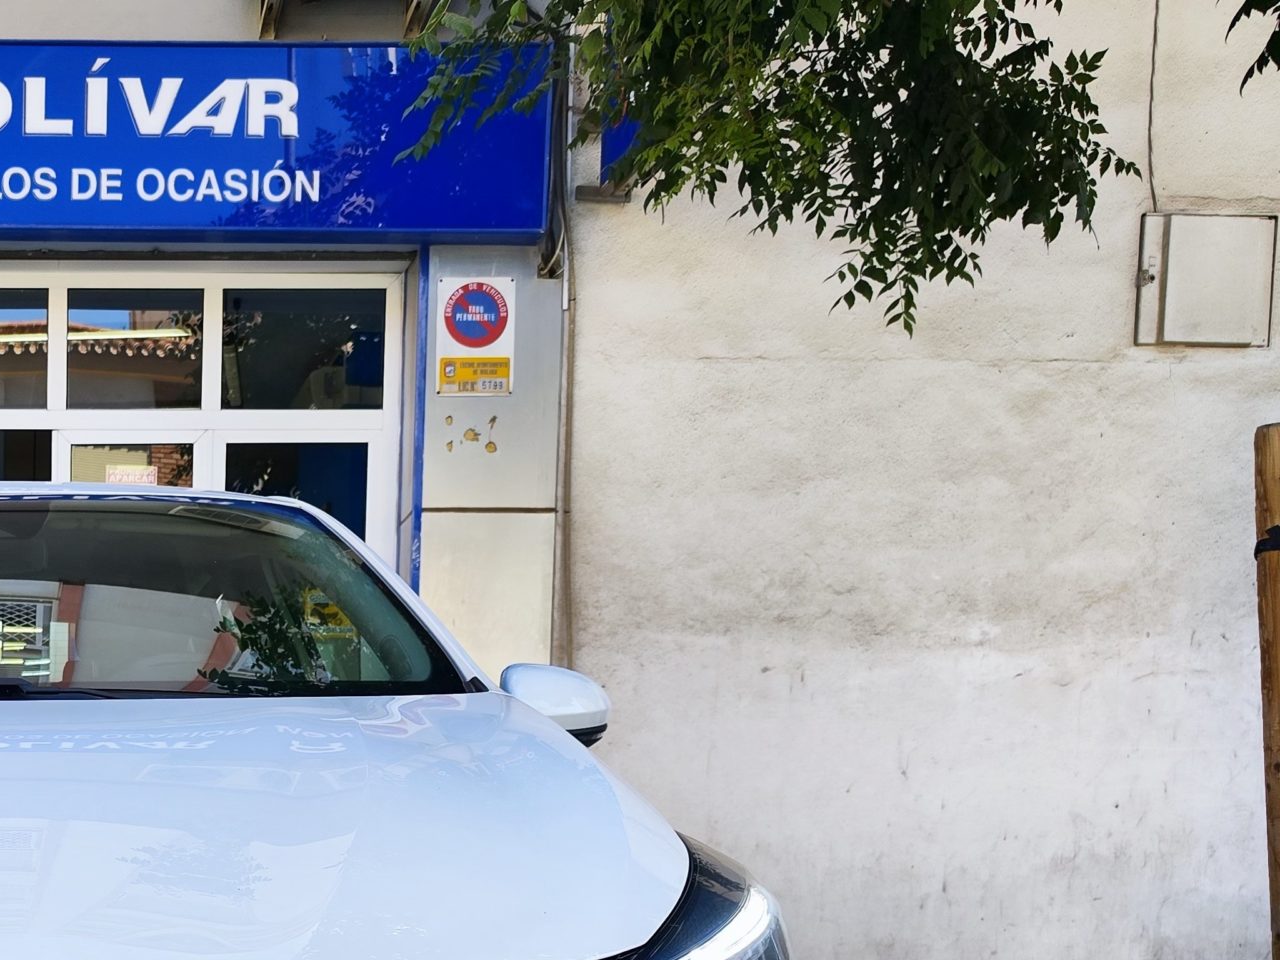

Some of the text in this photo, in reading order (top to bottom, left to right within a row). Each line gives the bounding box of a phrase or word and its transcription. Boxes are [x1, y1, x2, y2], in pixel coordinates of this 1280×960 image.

[71, 168, 123, 202] DE
[136, 160, 320, 203] OCASIÓN
[445, 288, 464, 317] ENTRADA
[455, 313, 496, 322] PERMANENTE
